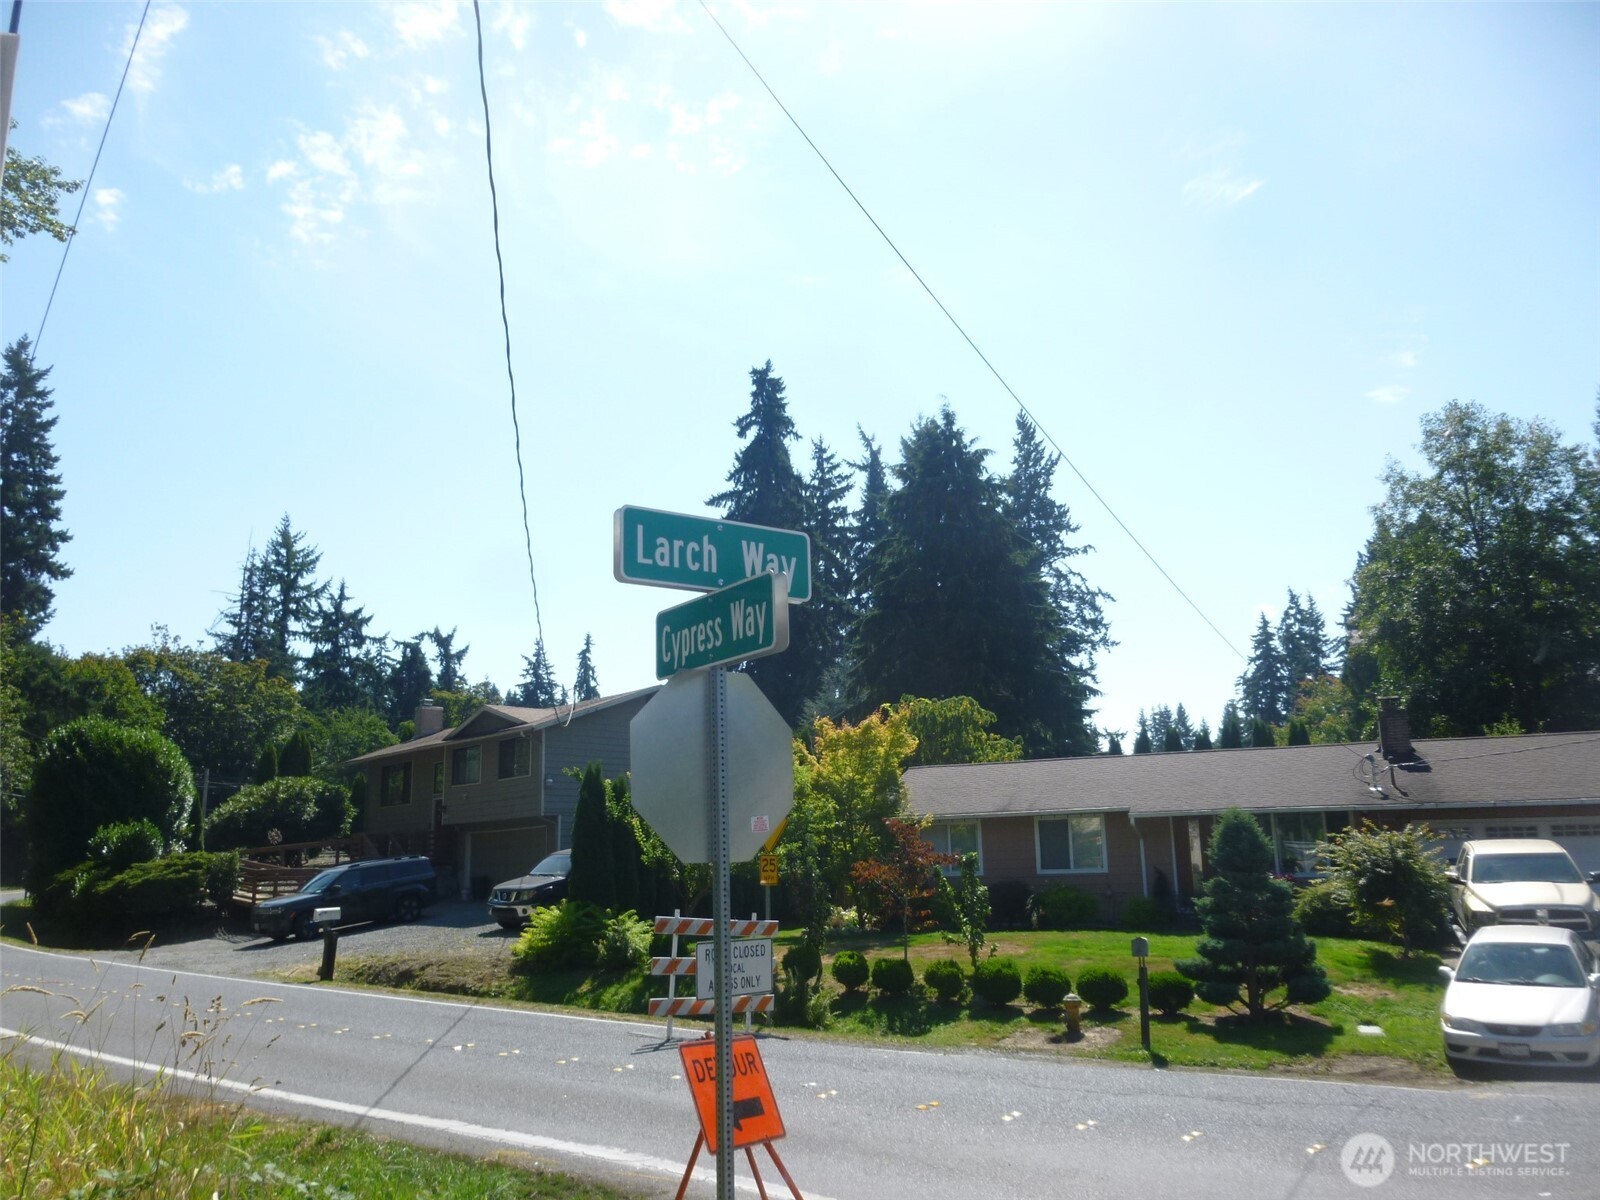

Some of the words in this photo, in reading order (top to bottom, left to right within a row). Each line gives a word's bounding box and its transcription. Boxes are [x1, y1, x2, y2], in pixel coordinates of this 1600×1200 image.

[637, 524, 718, 573] Larch
[741, 540, 797, 593] Way
[661, 617, 723, 670] Cypress
[730, 599, 767, 645] Way
[761, 858, 776, 873] 25
[733, 944, 766, 959] CLOSED
[730, 963, 745, 974] CAL
[741, 975, 761, 989] ONLY
[691, 1052, 760, 1083] DEUR
